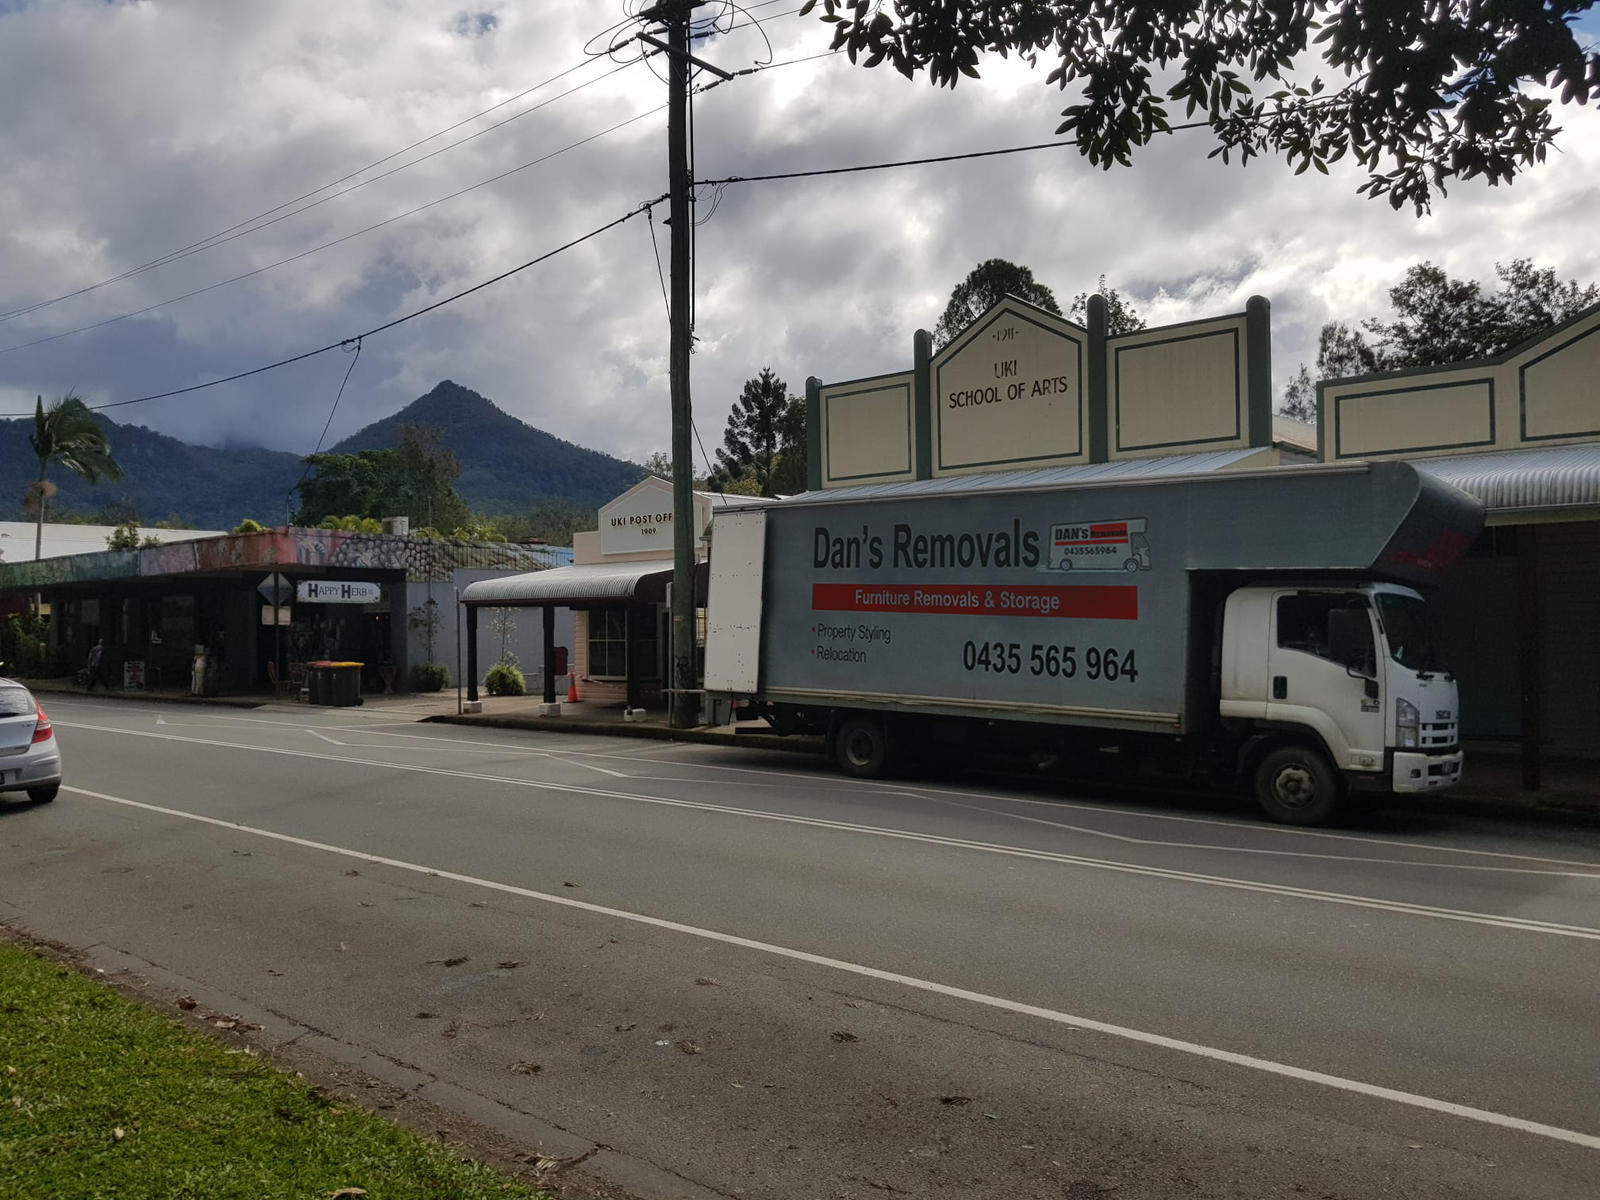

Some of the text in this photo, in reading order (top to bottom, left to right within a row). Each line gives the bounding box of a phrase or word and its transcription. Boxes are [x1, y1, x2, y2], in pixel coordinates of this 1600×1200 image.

[994, 359, 1017, 379] UKI
[949, 376, 1068, 409] SCHOOL OF ARTS
[611, 517, 626, 527] UKI
[629, 514, 652, 525] POST
[641, 527, 657, 535] 1909
[1055, 527, 1128, 541] DAN'S Removals
[813, 518, 1041, 569] Dan's Removals
[1063, 546, 1118, 556] 0435565964
[855, 589, 1060, 614] Furniture Removals & Storage
[817, 623, 892, 644] Property Styling
[816, 646, 867, 663] Relocation
[963, 640, 1138, 683] 0435 565 964
